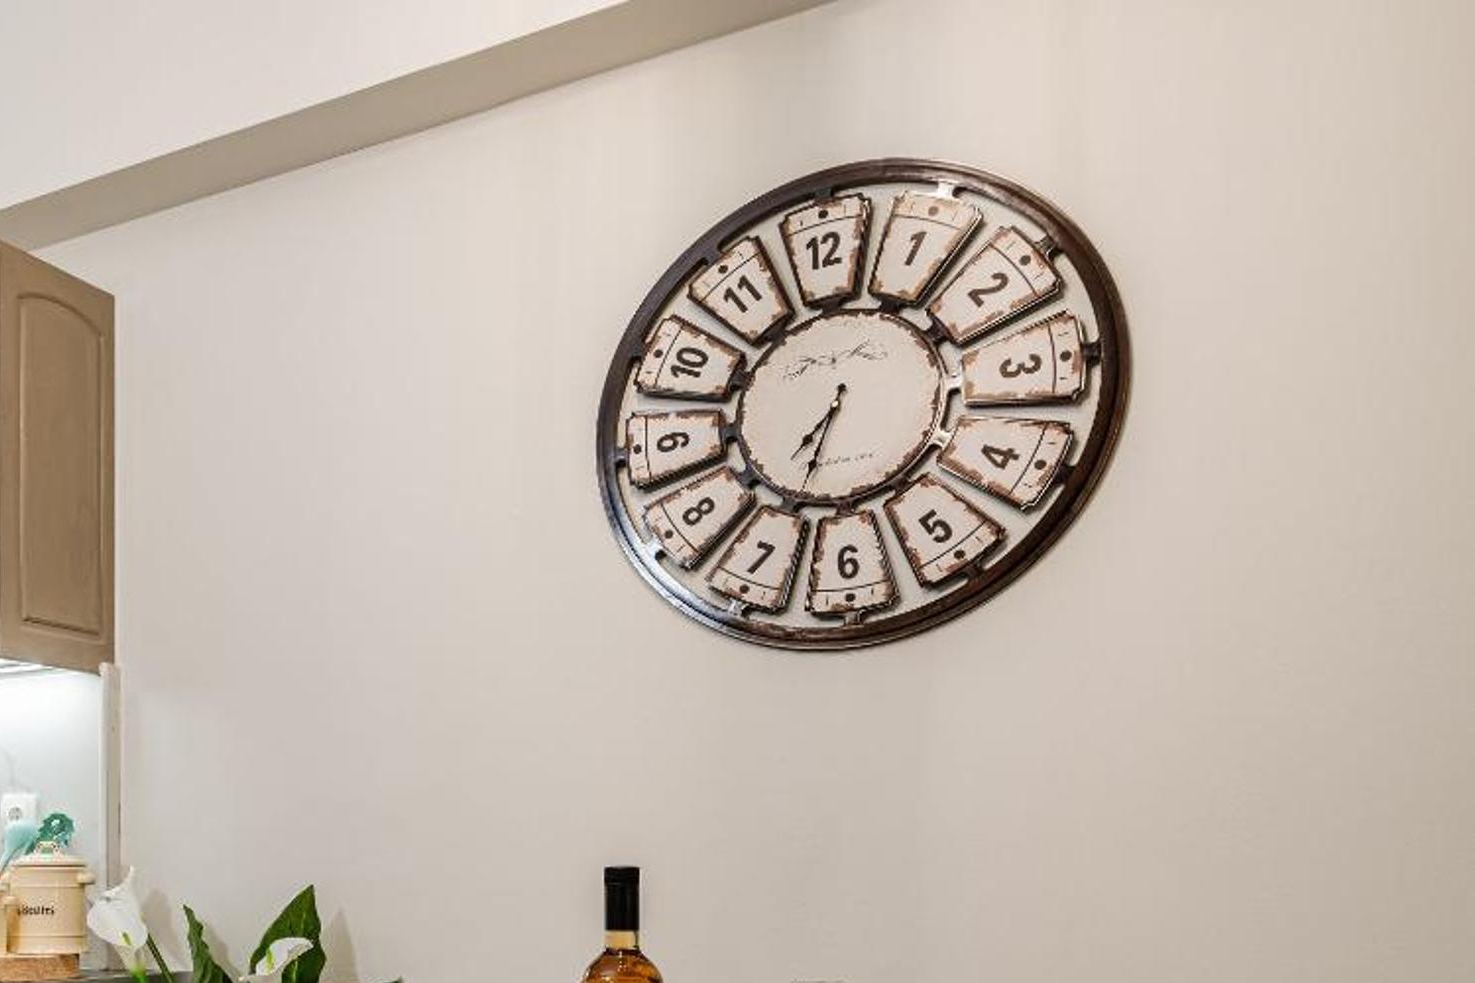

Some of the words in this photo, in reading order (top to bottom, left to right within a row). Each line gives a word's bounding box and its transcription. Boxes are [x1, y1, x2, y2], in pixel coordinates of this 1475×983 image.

[805, 231, 843, 271] 12
[904, 231, 927, 266] 1
[723, 275, 763, 314] 11
[967, 272, 1009, 308] 2
[670, 347, 709, 378] 10
[999, 353, 1042, 378] 3
[656, 431, 691, 453] 9
[981, 444, 1020, 470] 4
[682, 496, 715, 527] 8
[917, 508, 953, 544] 5
[746, 540, 776, 575] 7
[837, 544, 860, 580] 6
